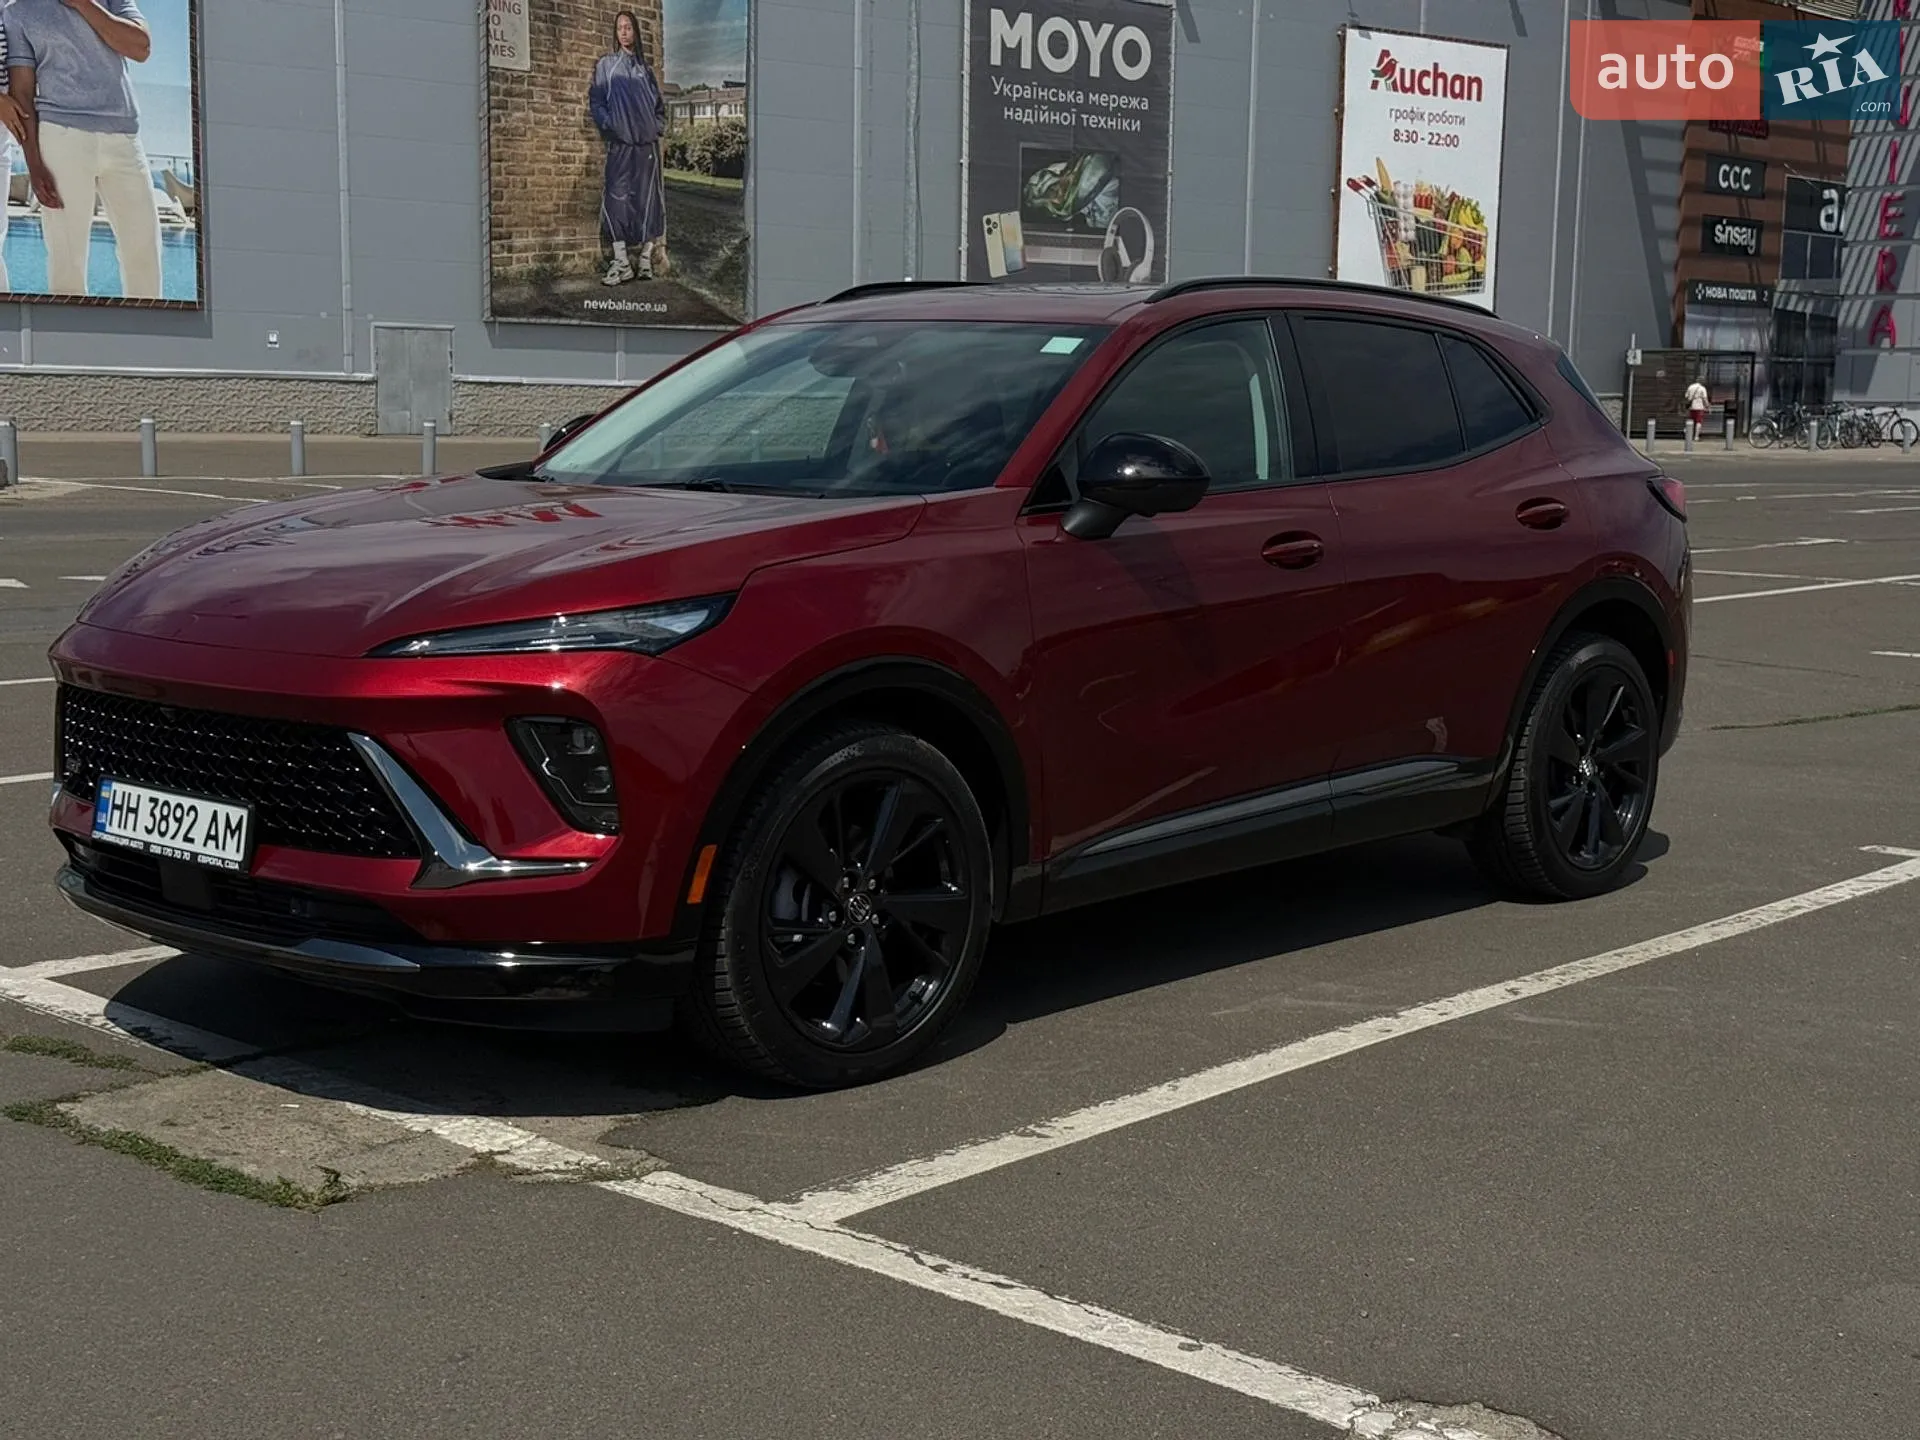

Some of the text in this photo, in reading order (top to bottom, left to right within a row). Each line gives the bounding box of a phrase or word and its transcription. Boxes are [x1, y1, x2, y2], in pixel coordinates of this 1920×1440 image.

[990, 8, 1152, 81] MOYO
[1370, 49, 1483, 102] Auchan
[991, 75, 1149, 113] Українська мережа
[1004, 105, 1141, 132] надійної техніки
[1389, 107, 1466, 126] графік роботи
[1393, 129, 1419, 144] 8:30
[1427, 132, 1460, 148] 22:00
[1718, 163, 1752, 191] CCC
[1714, 218, 1757, 255] sinsay
[584, 299, 668, 313] newbalance.ua
[1705, 286, 1727, 299] НОВА
[1728, 288, 1757, 302] ПОШТА
[109, 789, 244, 854] HH 3892 AM
